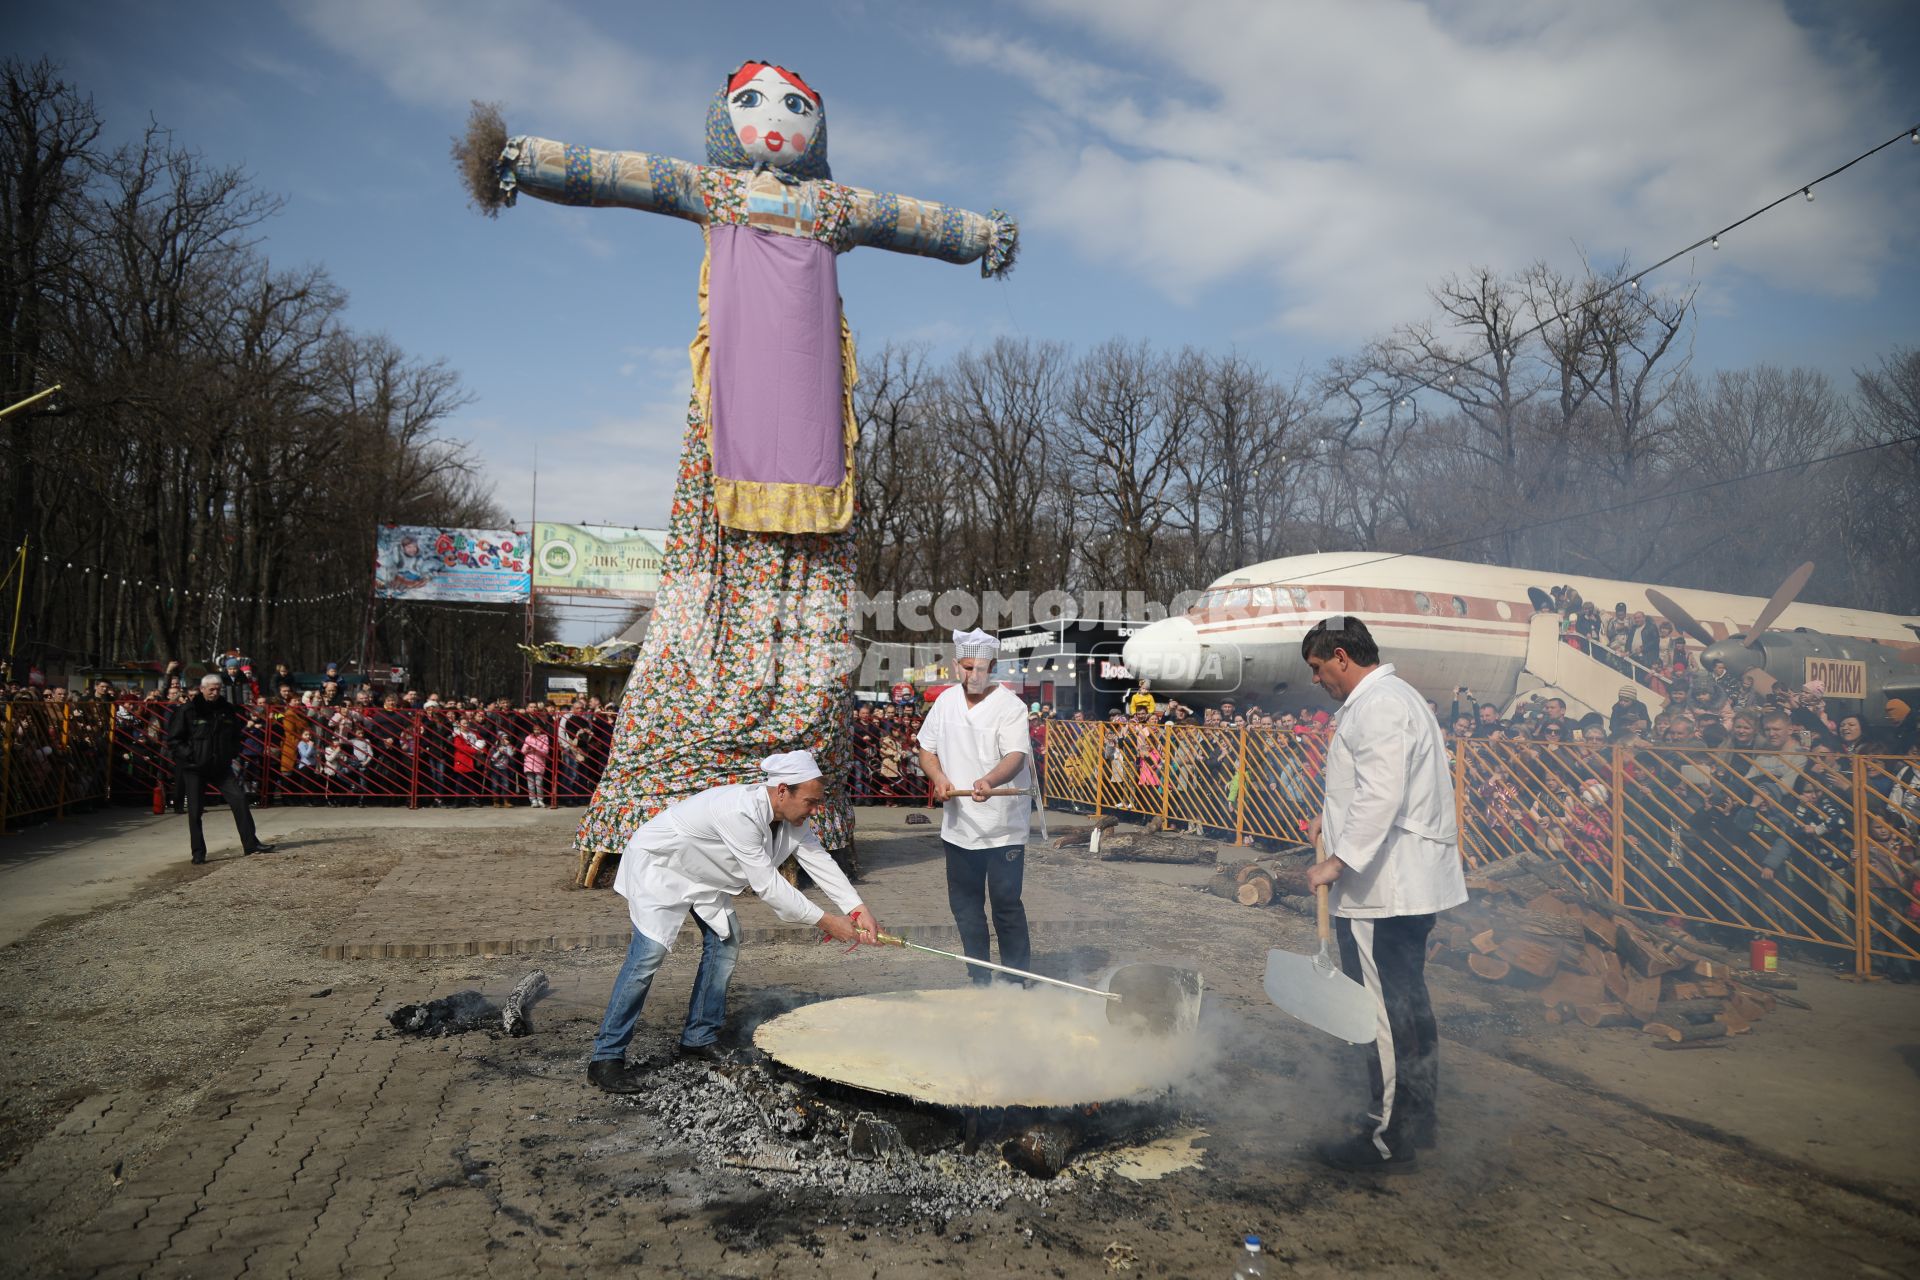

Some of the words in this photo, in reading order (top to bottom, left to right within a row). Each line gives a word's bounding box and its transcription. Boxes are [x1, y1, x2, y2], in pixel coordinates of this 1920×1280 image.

[436, 534, 524, 558] ДЕТСКОЕ
[444, 552, 523, 572] СЧАСТЬЕ
[1811, 662, 1861, 694] РОЛИКИ
